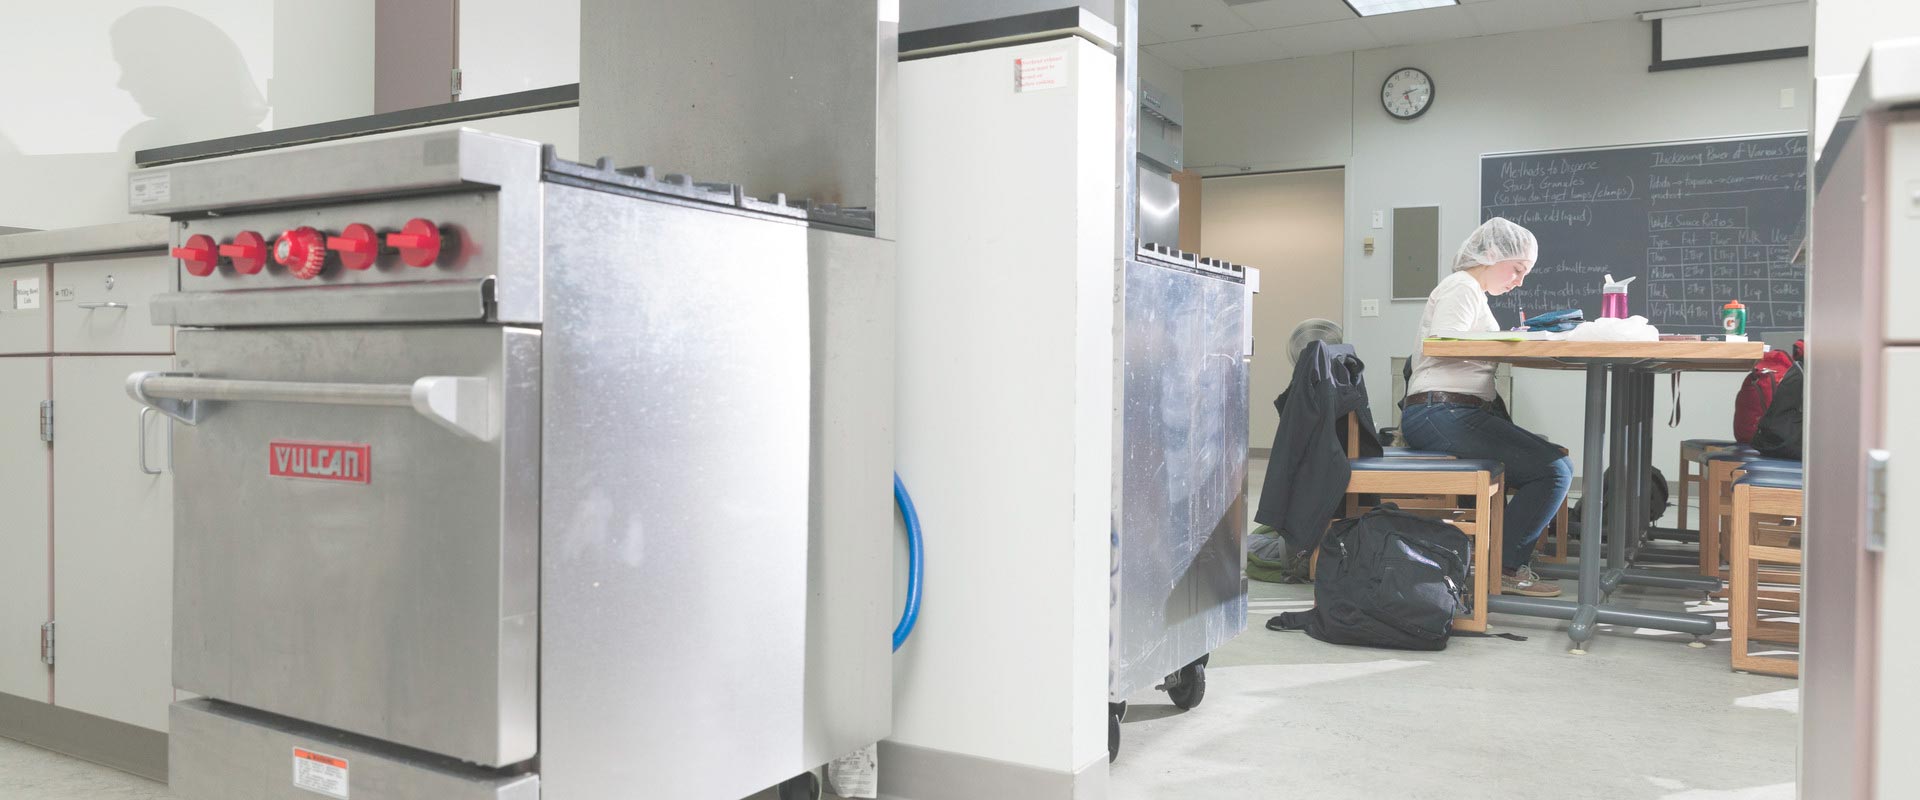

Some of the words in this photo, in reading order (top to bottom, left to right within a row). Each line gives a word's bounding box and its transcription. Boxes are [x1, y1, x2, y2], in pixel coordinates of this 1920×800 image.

[1706, 146, 1728, 161] Power
[1732, 142, 1745, 159] of
[1748, 143, 1784, 159] Various
[1501, 160, 1546, 179] Methods
[1547, 159, 1558, 175] to
[1560, 158, 1599, 177] Disperse
[1503, 177, 1534, 193] Starch
[1540, 175, 1585, 190] Granules
[1702, 211, 1735, 228] Ratios
[1681, 231, 1699, 246] Fat
[1723, 316, 1738, 331] G
[274, 446, 359, 478] VULCAN
